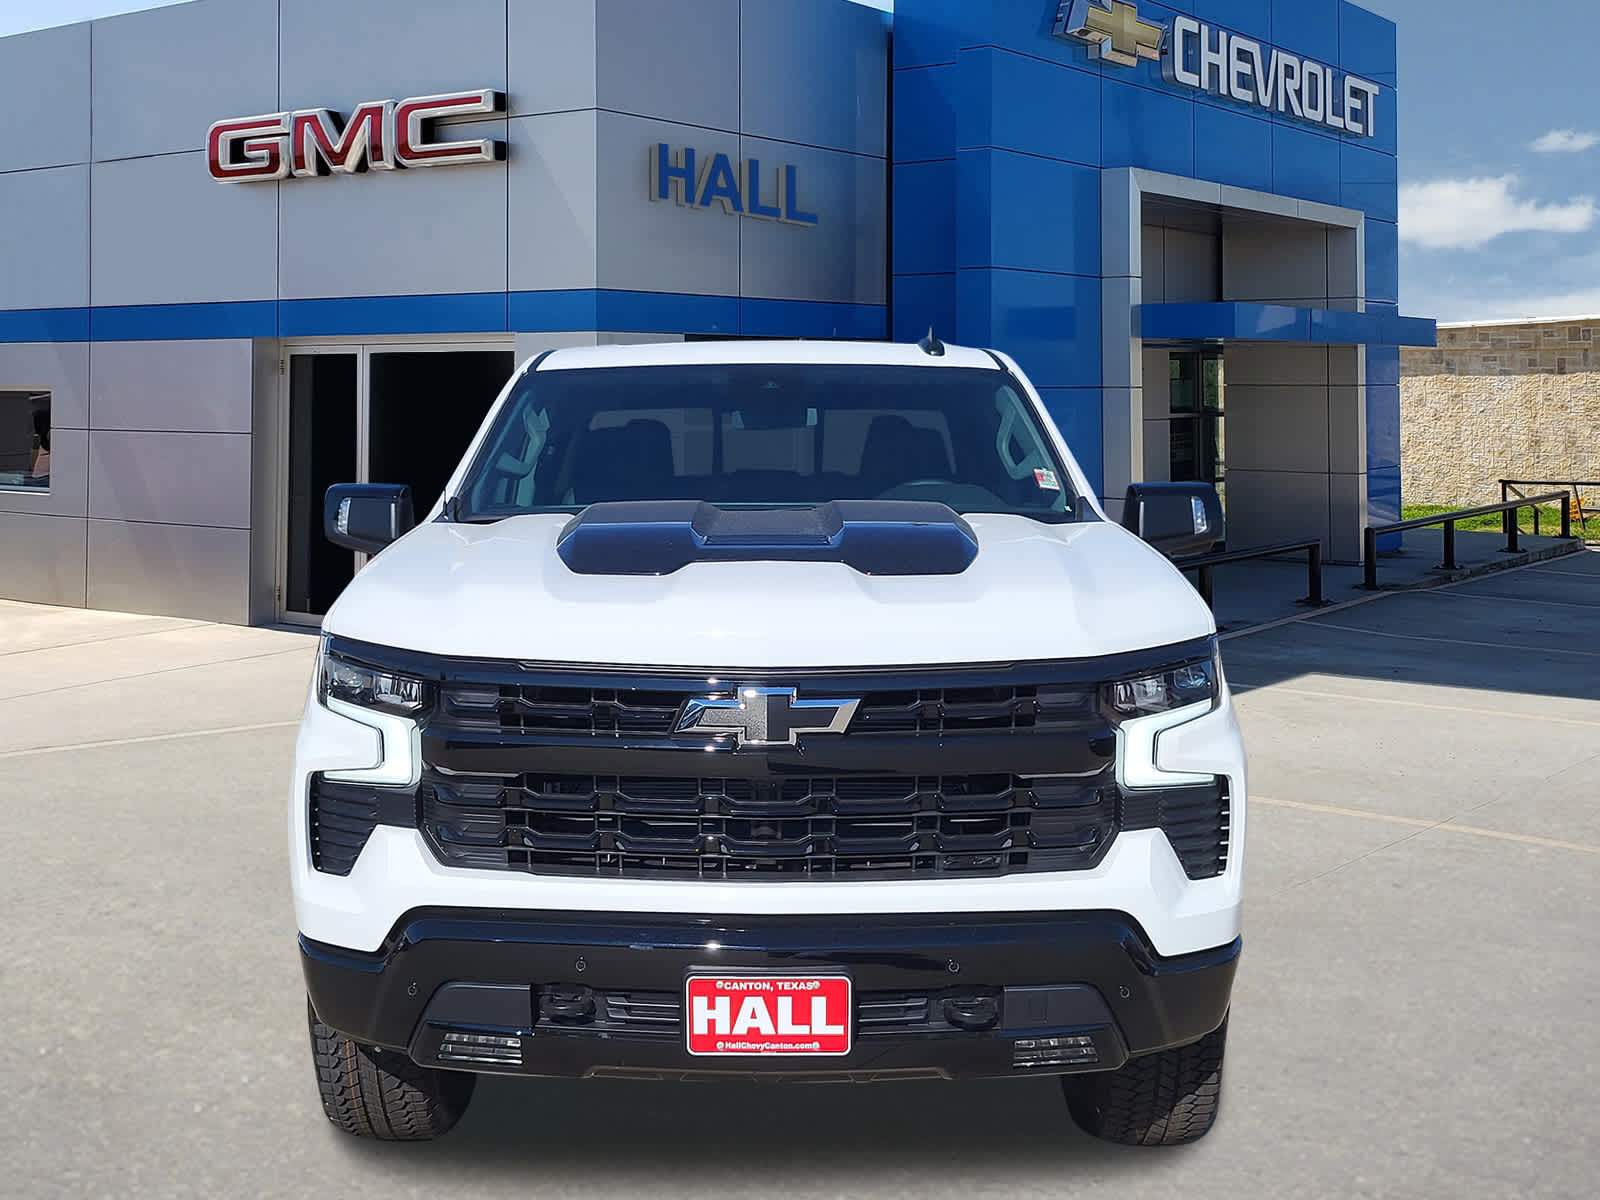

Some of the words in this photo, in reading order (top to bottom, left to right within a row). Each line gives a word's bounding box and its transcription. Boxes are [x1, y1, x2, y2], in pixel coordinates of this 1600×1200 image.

[1172, 16, 1380, 137] CHEVROLET
[207, 89, 503, 184] GMC
[654, 143, 818, 226] HALL
[692, 996, 844, 1035] HALL
[723, 982, 774, 992] CANTON,
[777, 982, 814, 991] TEXAS
